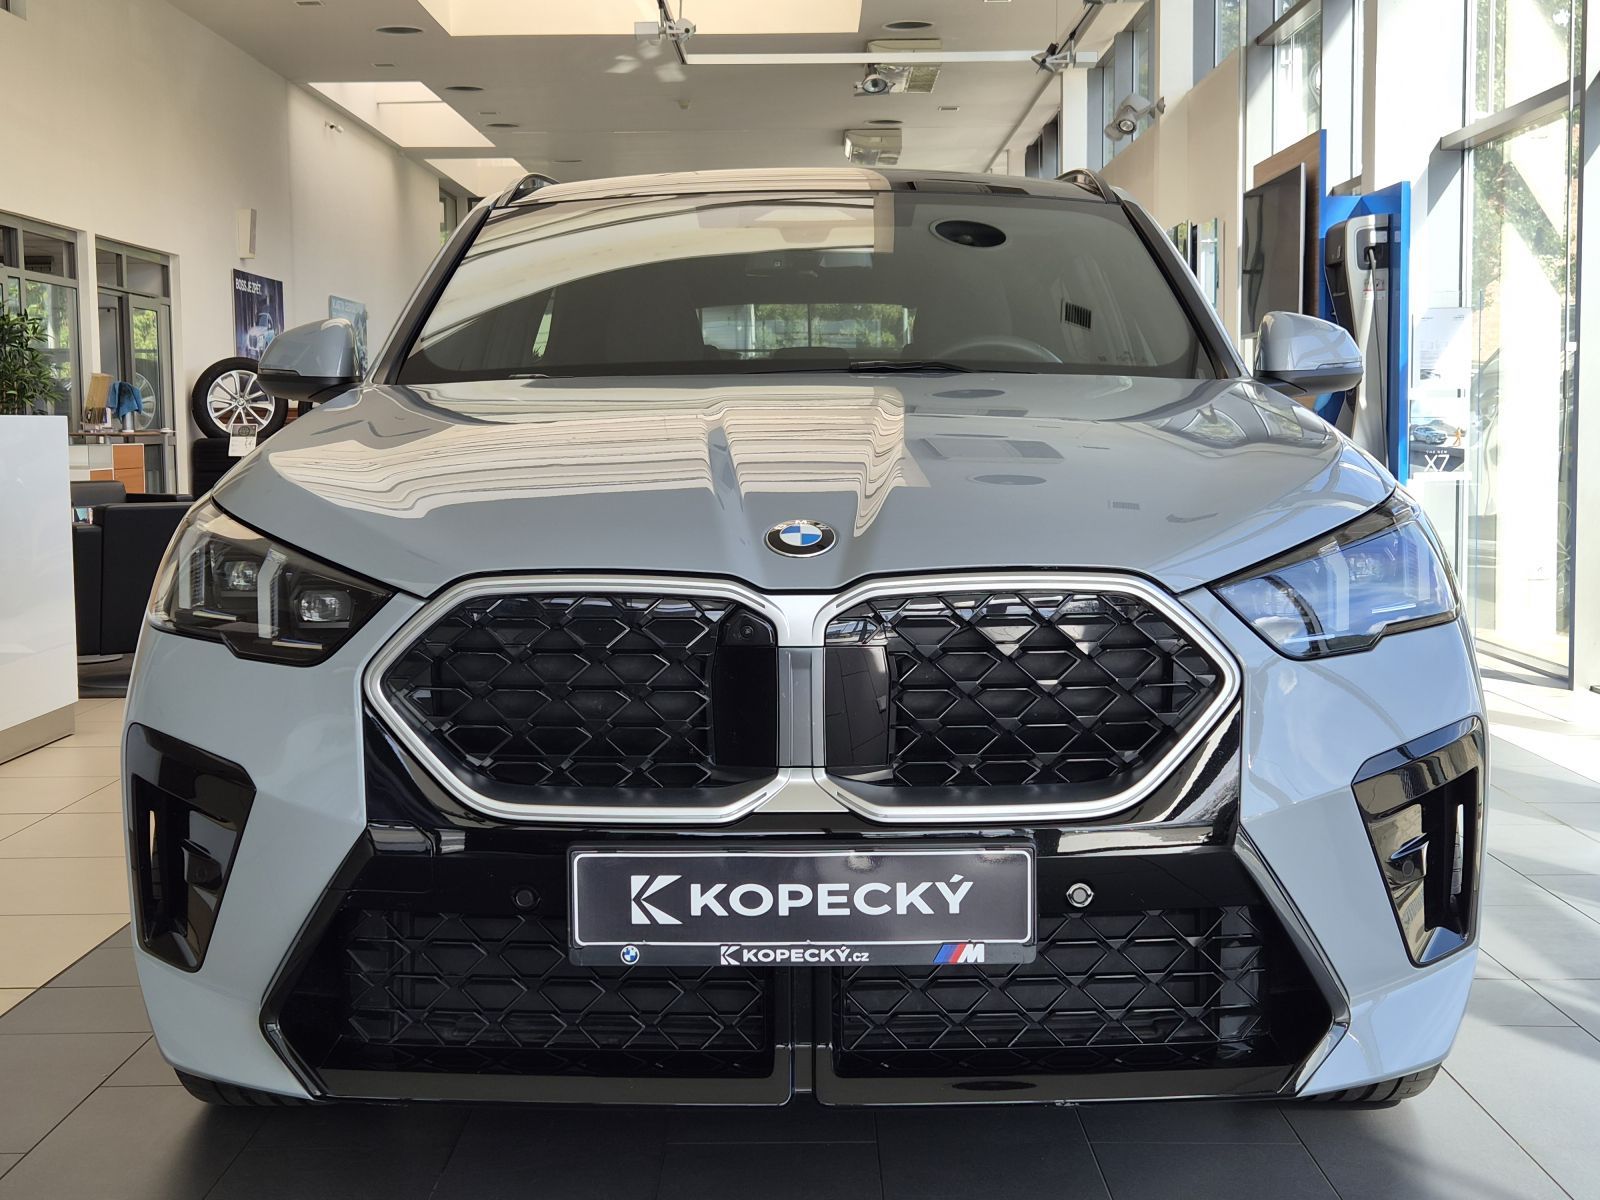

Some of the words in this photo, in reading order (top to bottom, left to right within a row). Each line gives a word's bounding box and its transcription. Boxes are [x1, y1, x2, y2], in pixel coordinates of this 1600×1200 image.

[235, 278, 247, 292] BOSS
[1424, 454, 1450, 472] X7
[690, 873, 974, 917] KOPECKÝ
[742, 946, 870, 963] KOPECKÝ.cz
[956, 943, 985, 963] M
